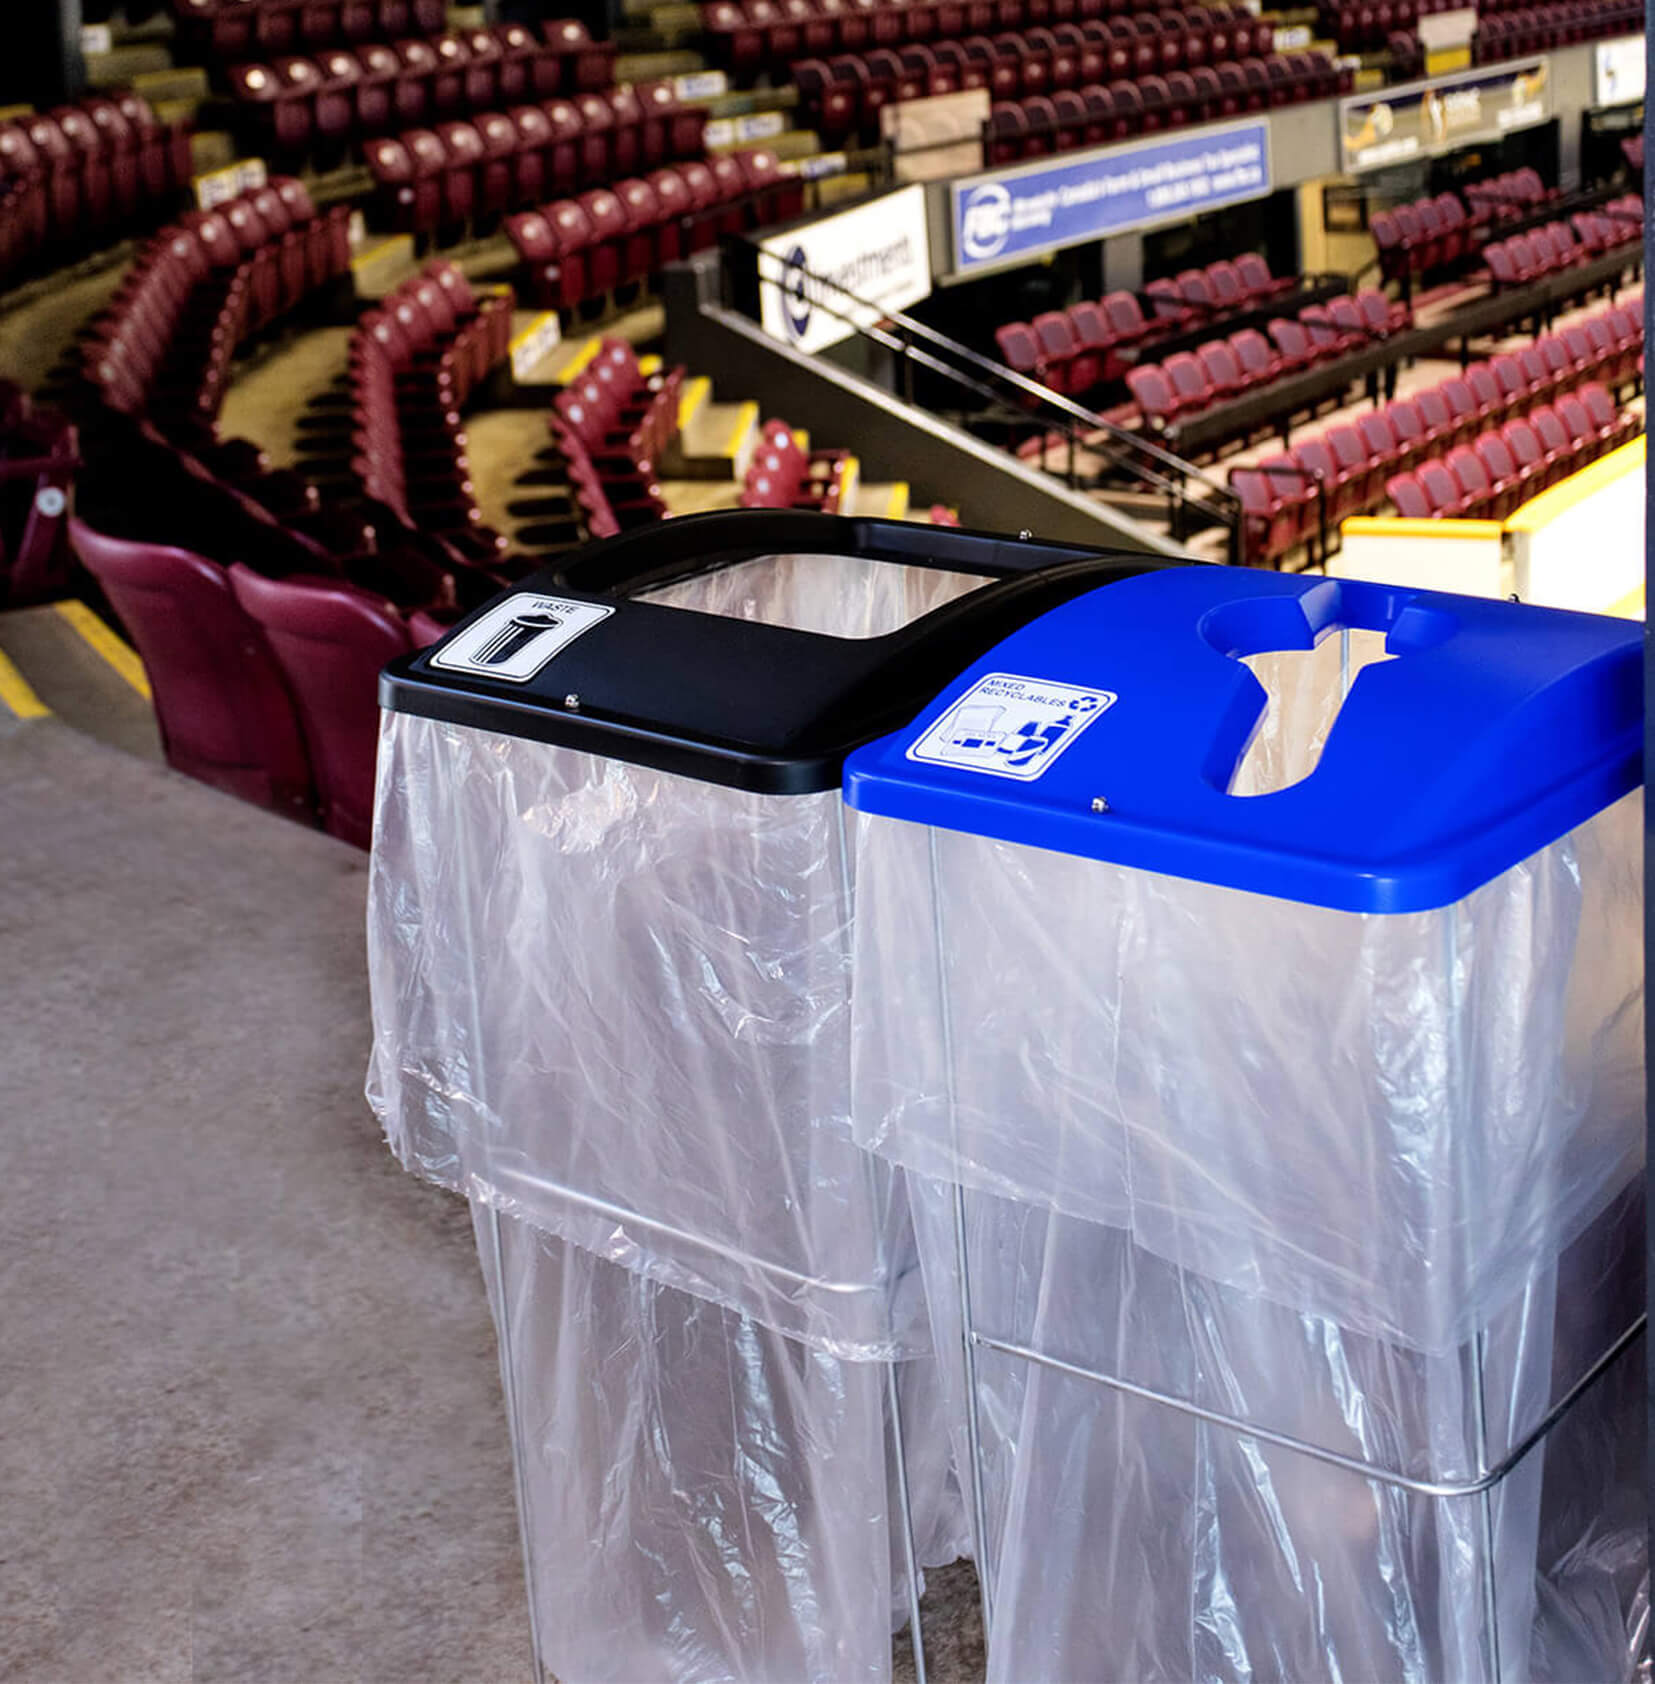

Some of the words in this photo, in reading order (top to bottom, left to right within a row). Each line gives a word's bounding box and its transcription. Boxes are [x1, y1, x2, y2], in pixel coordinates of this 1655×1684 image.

[532, 601, 578, 614] WASTE
[988, 680, 1026, 690] MIXED
[979, 687, 1066, 707] RECYCLABLES
